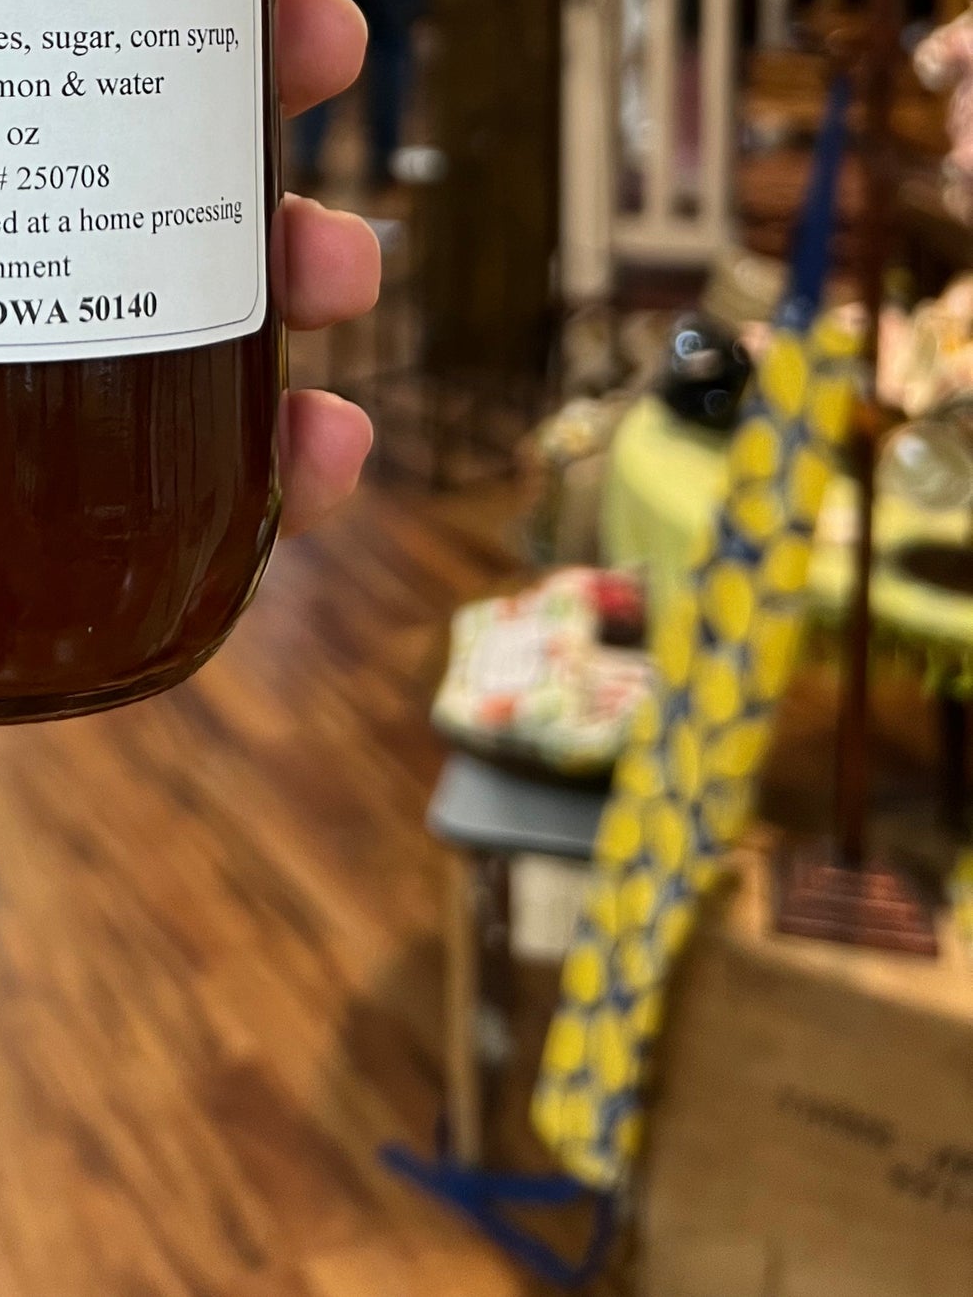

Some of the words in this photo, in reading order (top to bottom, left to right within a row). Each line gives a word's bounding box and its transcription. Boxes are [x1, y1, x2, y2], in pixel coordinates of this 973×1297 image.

[42, 31, 121, 56] sugar,
[131, 29, 180, 47] corn
[188, 28, 238, 53] syrup,
[62, 71, 86, 97] &
[96, 73, 164, 95] water
[7, 127, 39, 145] oz
[17, 164, 109, 190] 250708
[28, 213, 50, 233] at
[58, 216, 71, 233] a
[80, 208, 144, 231] home
[152, 197, 242, 234] processing
[79, 292, 157, 322] 50140
